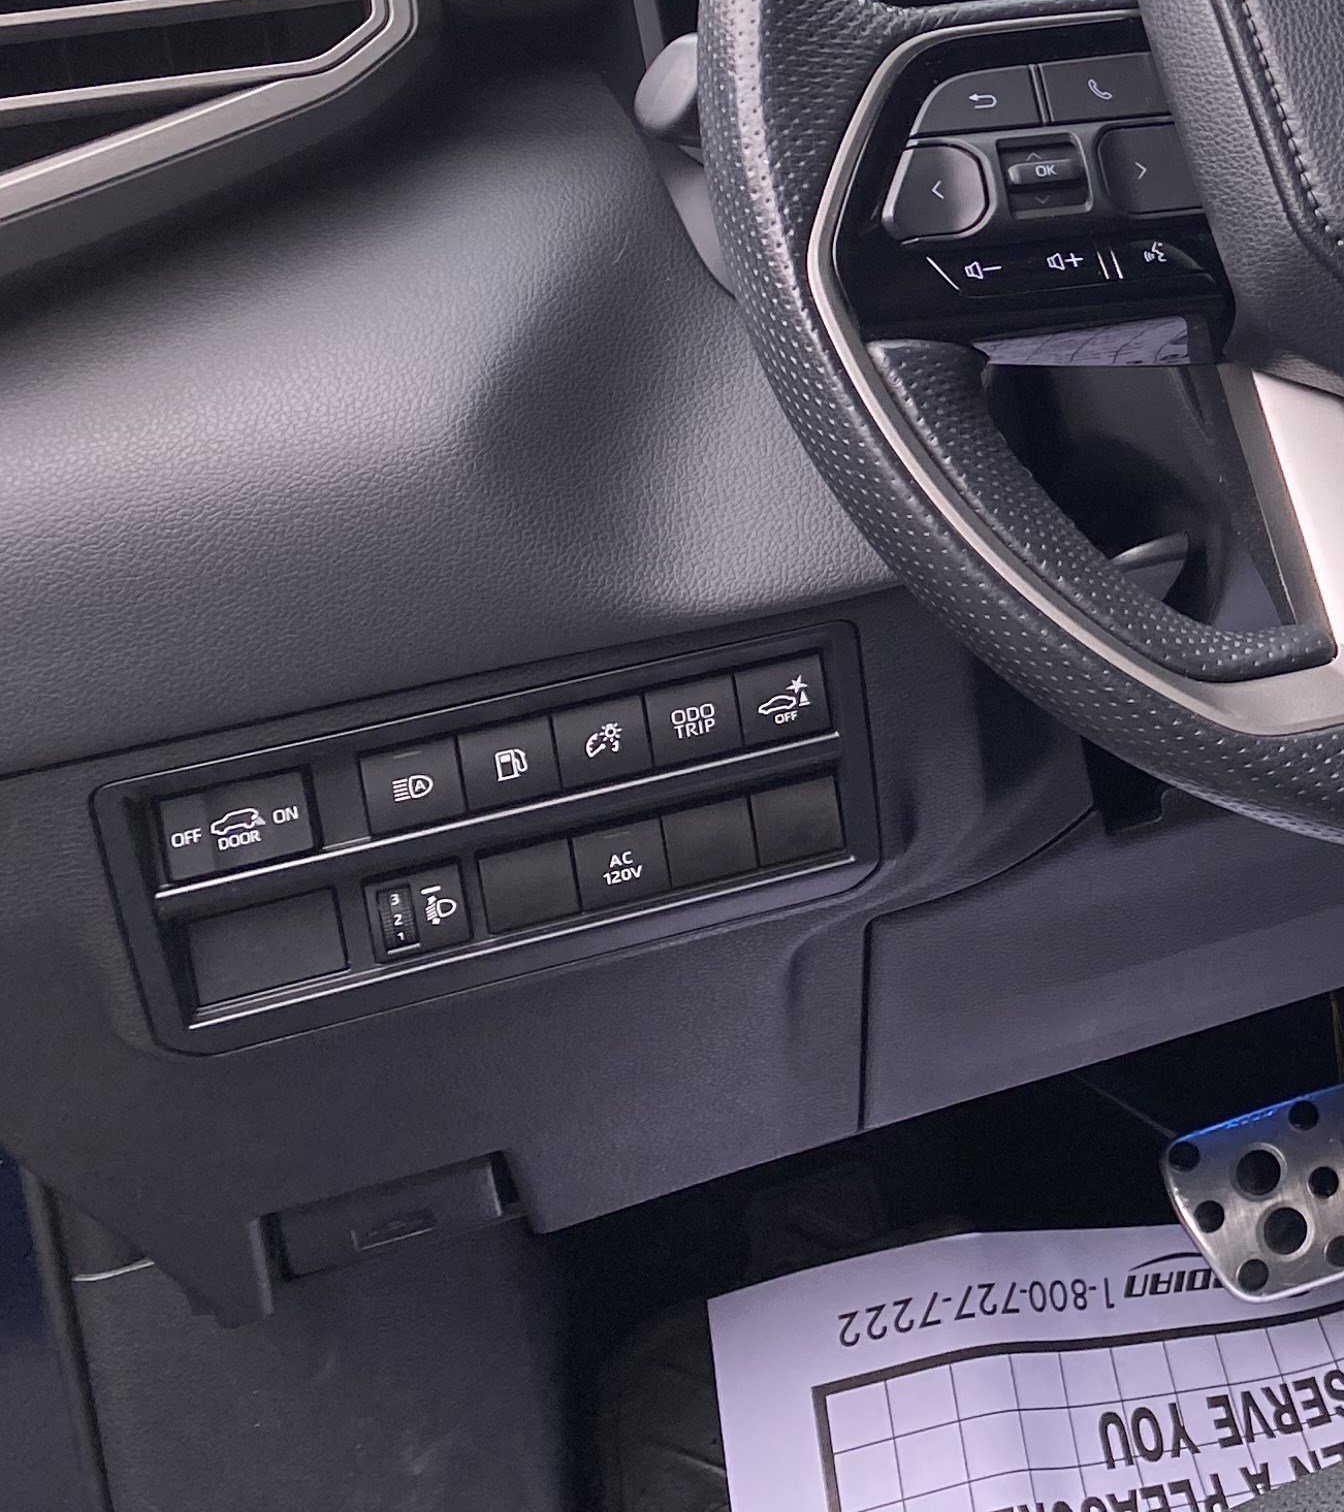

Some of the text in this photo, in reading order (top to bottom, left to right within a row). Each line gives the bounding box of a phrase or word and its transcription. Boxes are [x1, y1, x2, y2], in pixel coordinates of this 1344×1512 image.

[1034, 160, 1057, 180] OK
[671, 703, 715, 726] ODO
[774, 710, 799, 725] OFF
[672, 717, 716, 740] TRIP
[170, 805, 300, 849] OFF ON
[217, 829, 262, 851] DOOR
[609, 850, 634, 869] AC
[601, 864, 643, 887] 120V
[389, 893, 401, 907] 3
[393, 914, 404, 926] 2
[396, 931, 406, 942] 1
[837, 1267, 1222, 1349] DIAN 1-800-727-7222
[1098, 1401, 1202, 1471] YOU
